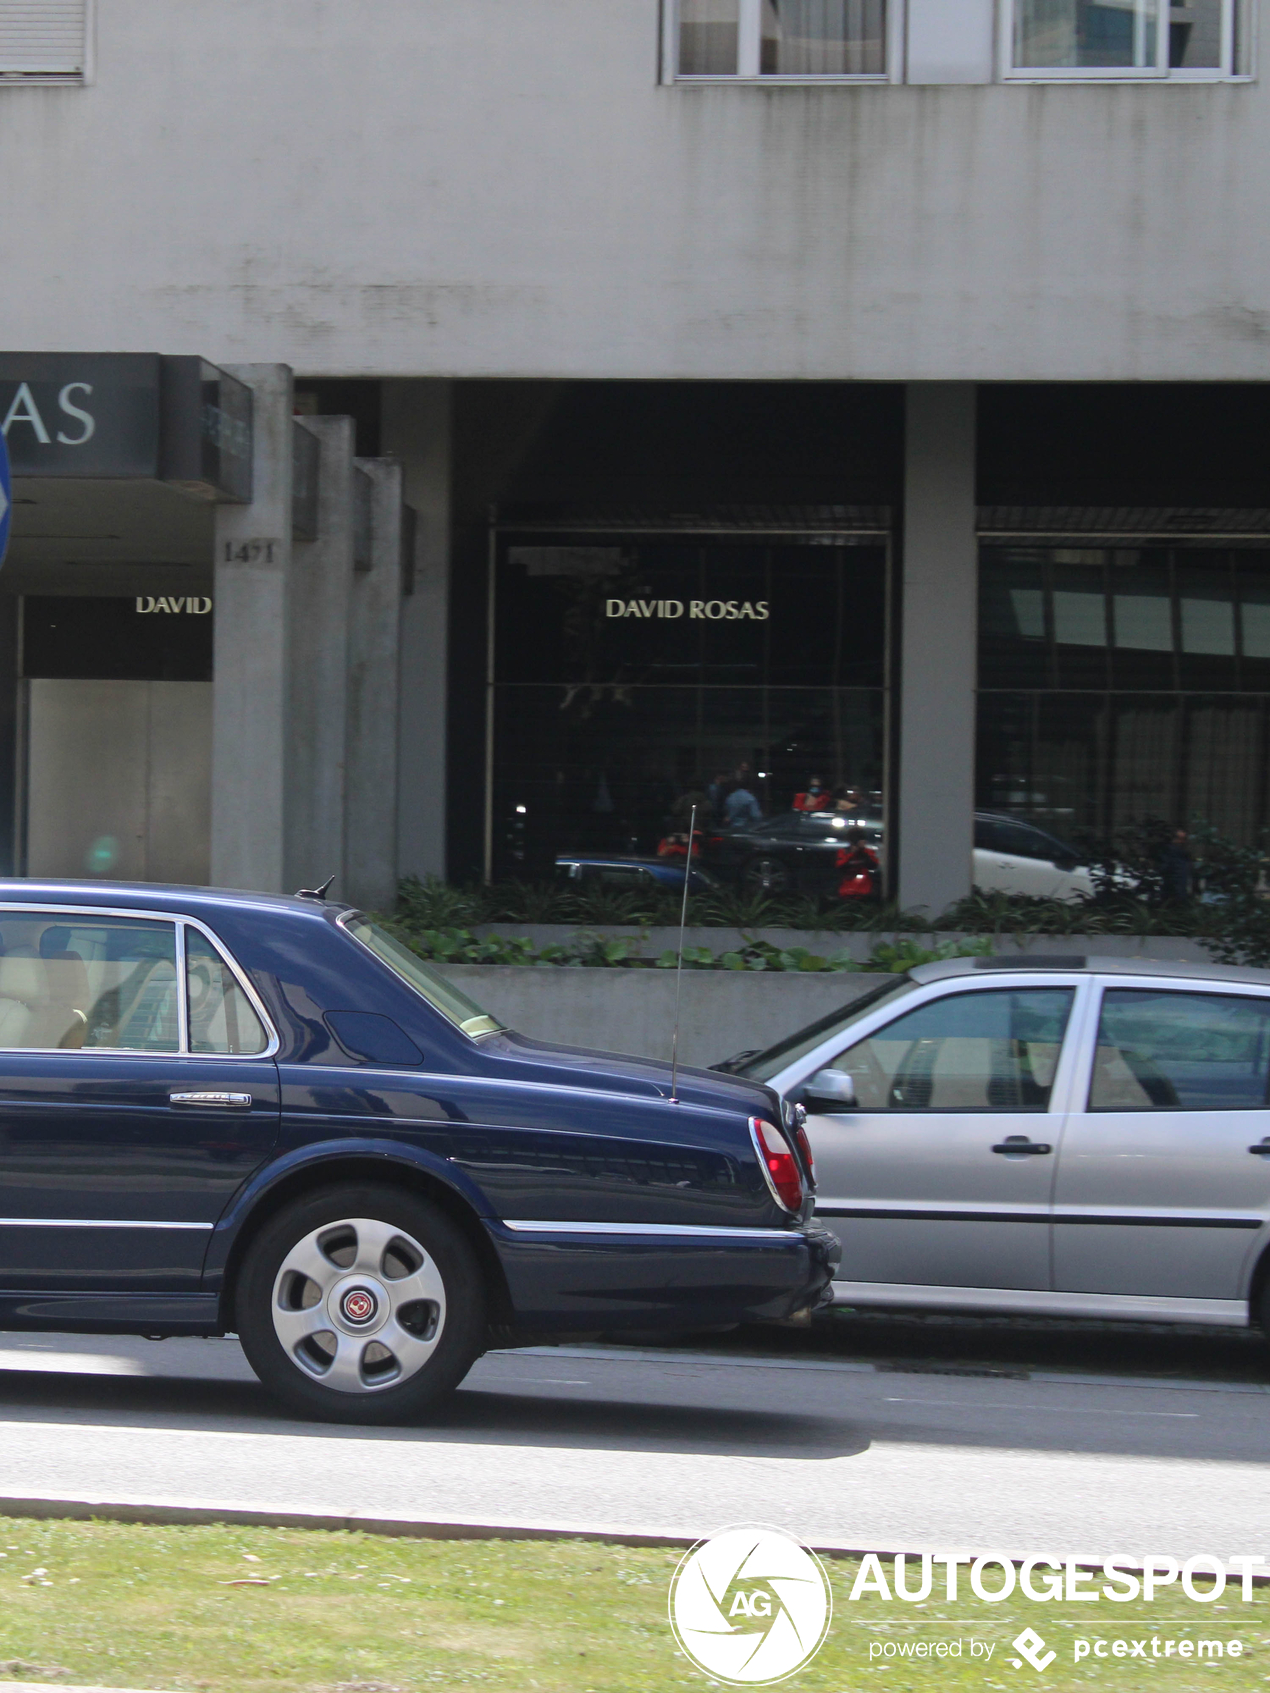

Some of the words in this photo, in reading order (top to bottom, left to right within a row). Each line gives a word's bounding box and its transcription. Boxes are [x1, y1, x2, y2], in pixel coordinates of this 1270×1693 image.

[224, 541, 274, 563] 1471
[136, 596, 213, 614] DAVID
[606, 599, 684, 618] DAVID
[689, 601, 769, 619] ROSAS
